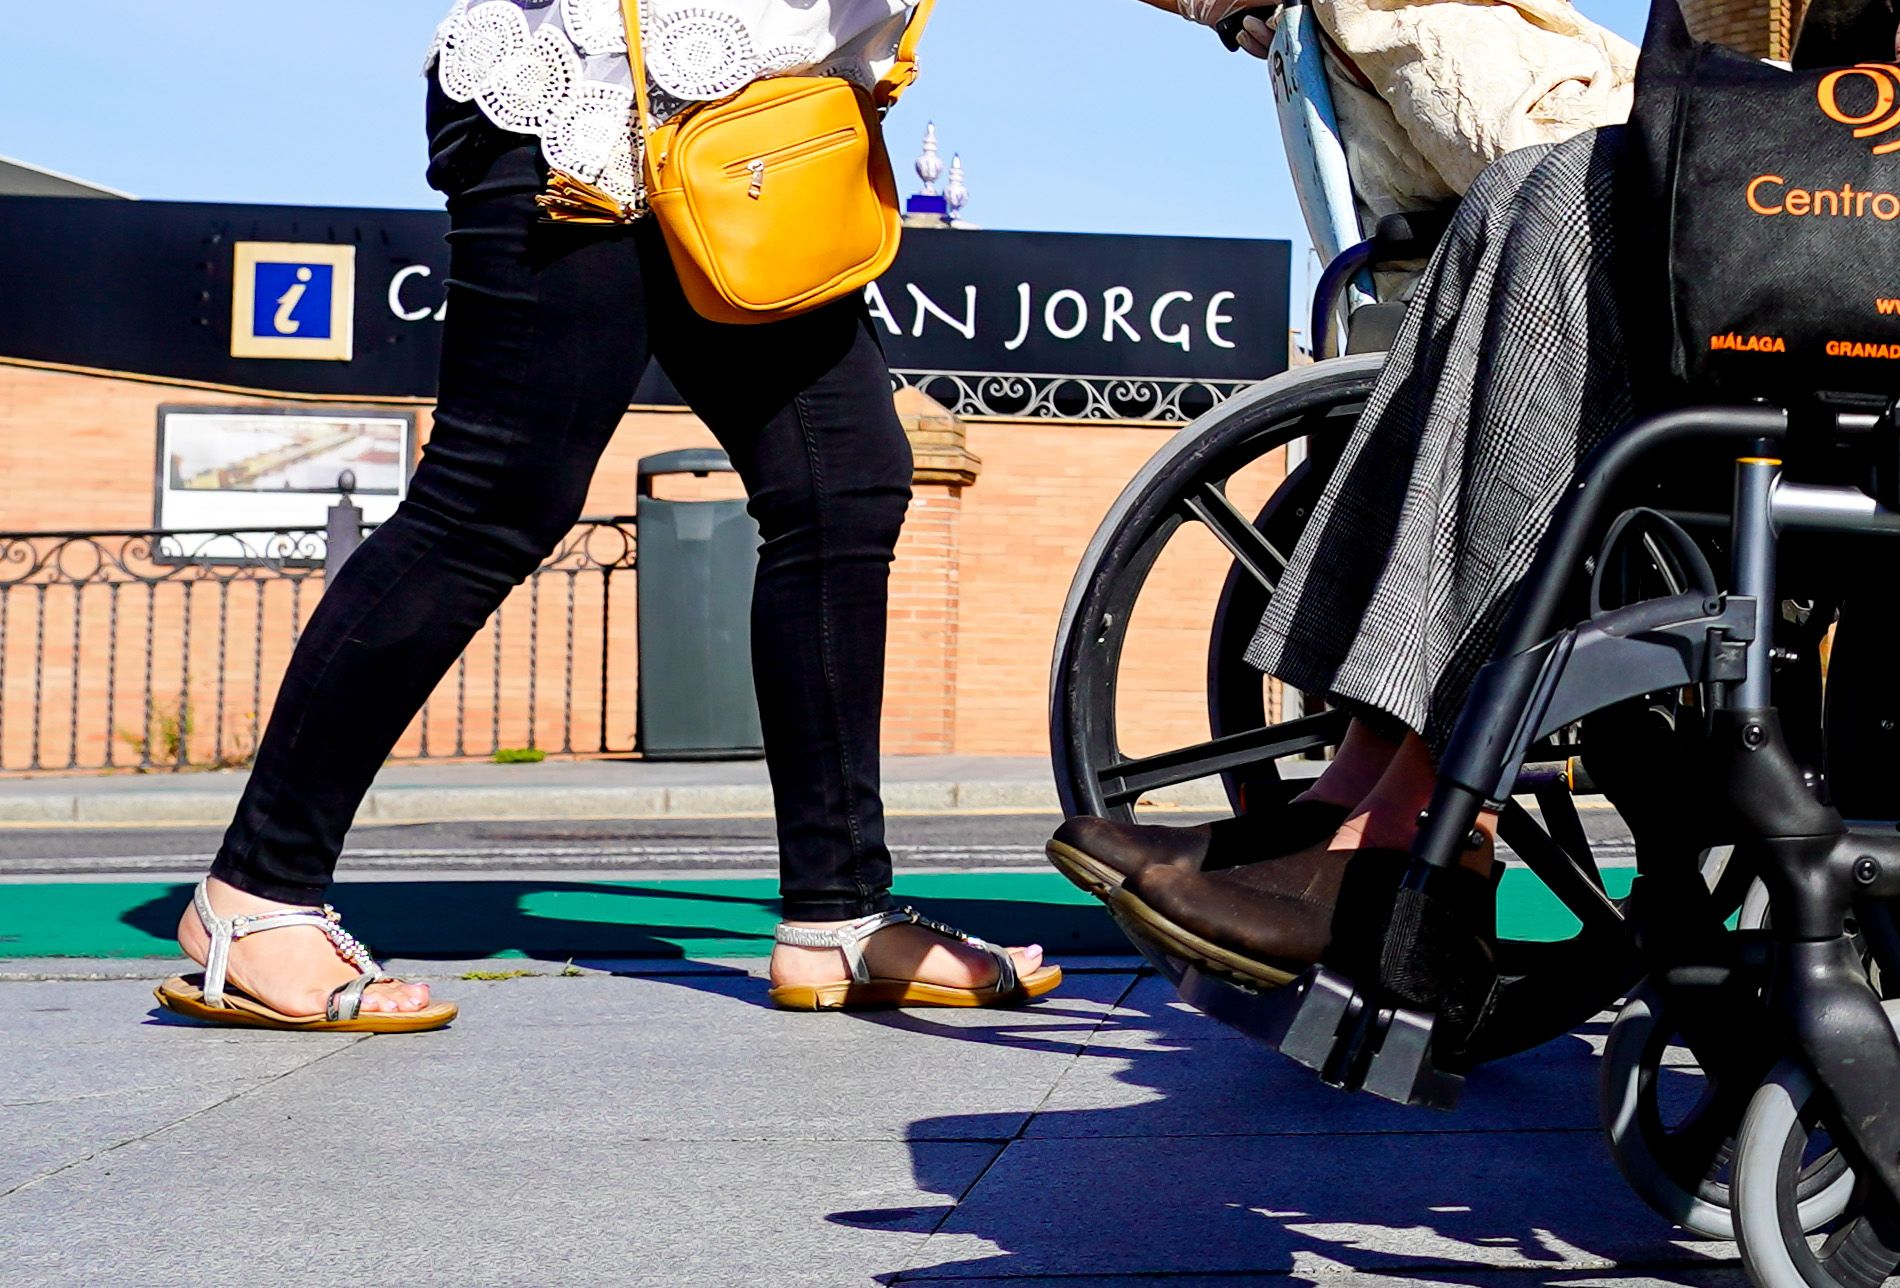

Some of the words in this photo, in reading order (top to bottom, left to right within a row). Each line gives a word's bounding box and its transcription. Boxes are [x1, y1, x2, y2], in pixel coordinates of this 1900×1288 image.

[388, 265, 448, 321] C
[864, 280, 977, 340] AN
[1004, 281, 1236, 352] JORGE
[1710, 331, 1786, 353] MÁLAGA
